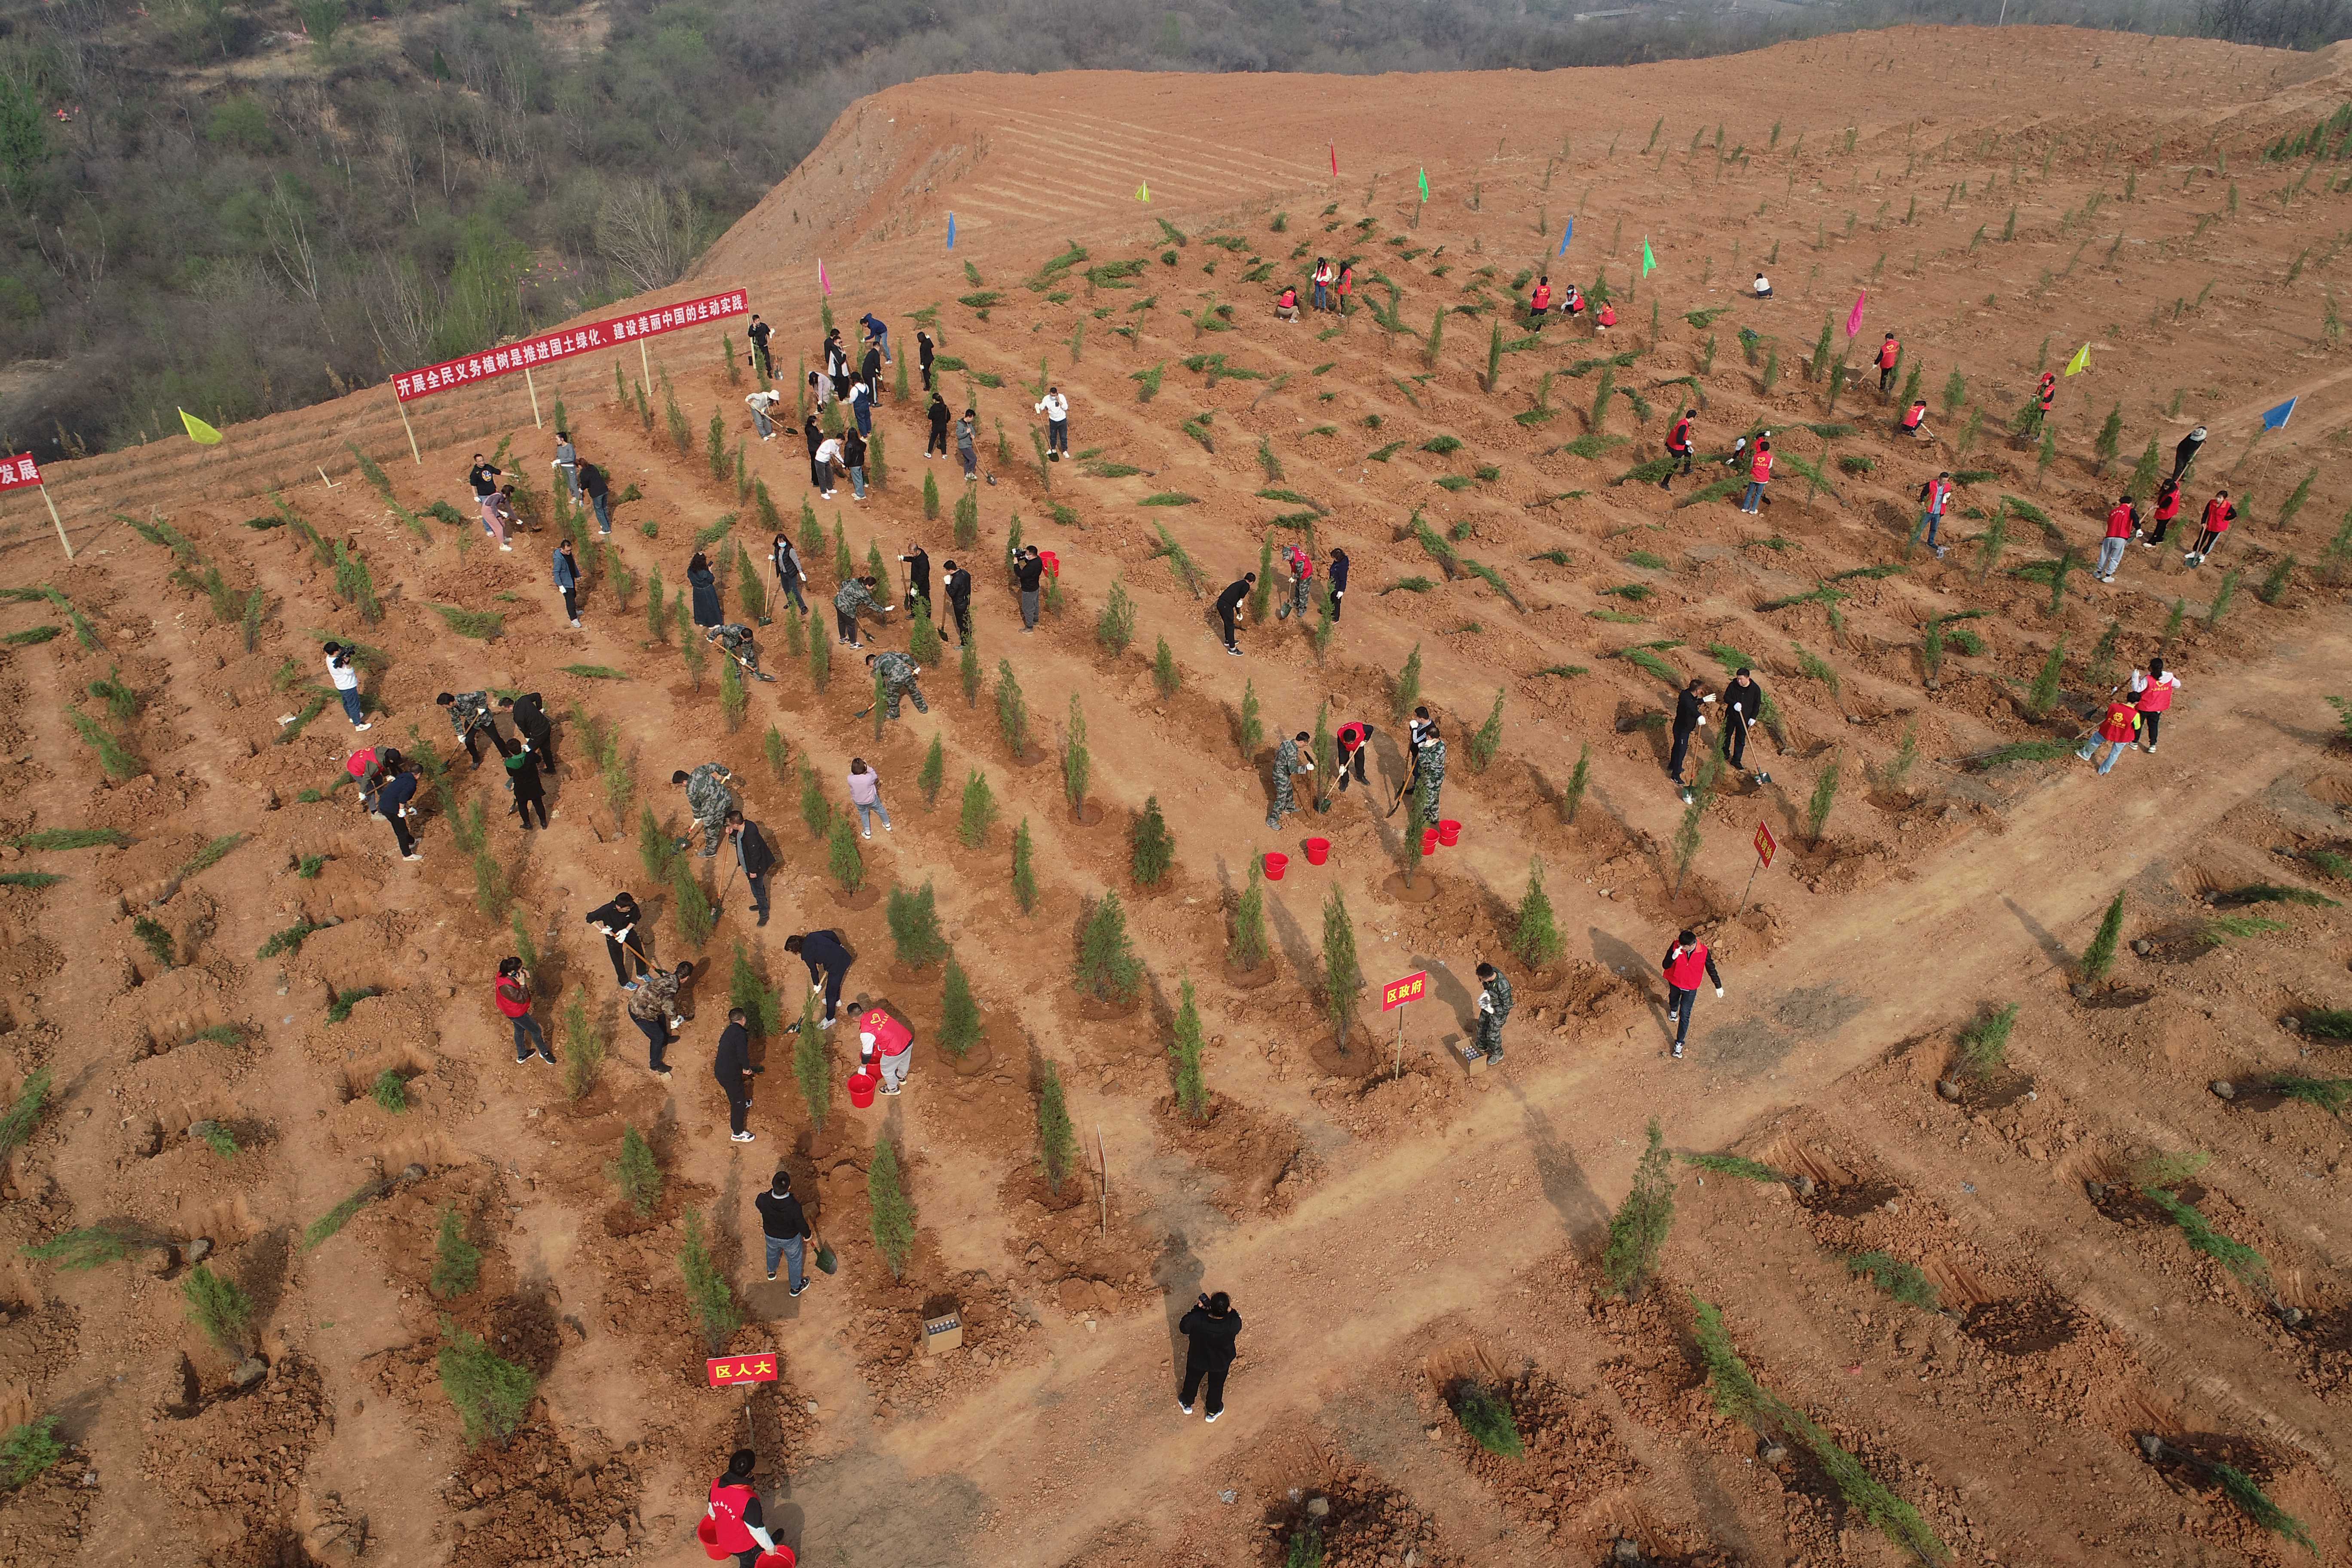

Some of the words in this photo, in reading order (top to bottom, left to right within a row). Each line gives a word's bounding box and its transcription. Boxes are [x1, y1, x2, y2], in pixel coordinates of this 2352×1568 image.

[396, 294, 748, 397] 开展全民义务植树是推进国土绿化、建设美丽中国的生动实践。
[0, 459, 39, 484] 发展
[1387, 980, 1423, 1003] 区政府
[716, 1361, 772, 1378] 区人大
